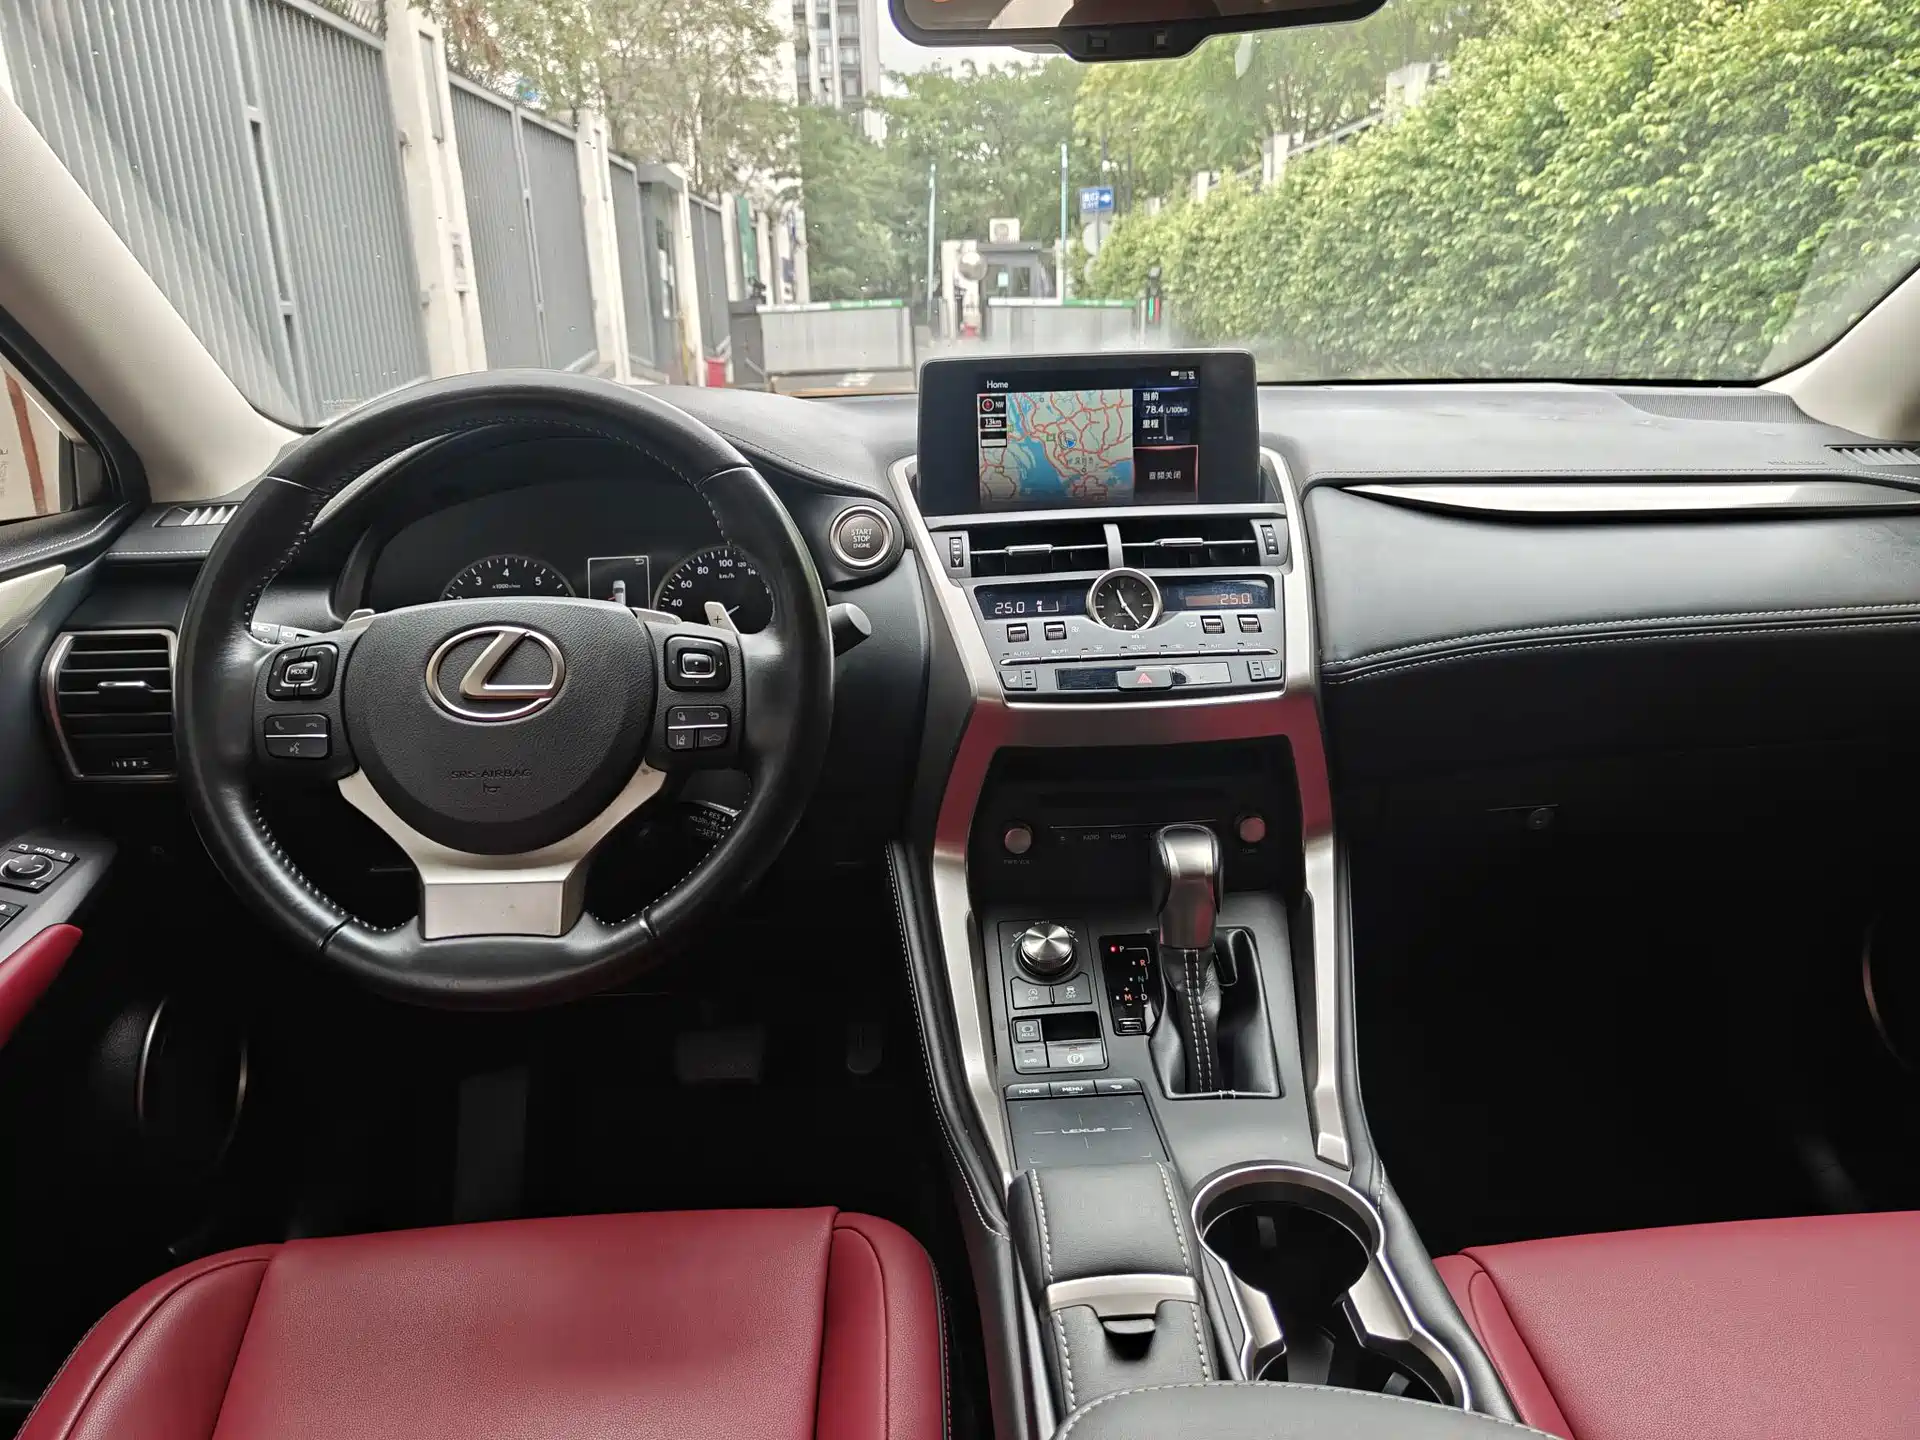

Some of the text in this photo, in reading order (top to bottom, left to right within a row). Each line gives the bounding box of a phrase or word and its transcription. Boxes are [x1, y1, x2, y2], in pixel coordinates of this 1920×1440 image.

[986, 380, 1009, 389] Home
[995, 401, 1005, 409] NW
[1145, 405, 1164, 414] 78.4
[853, 535, 871, 543] STOP
[719, 559, 733, 567] 100
[502, 568, 510, 577] 4
[697, 566, 709, 575] 80
[475, 576, 482, 586] 3
[534, 576, 542, 586] 5
[680, 580, 692, 588] 60
[671, 599, 683, 607] 40
[994, 602, 1025, 614] 25.0
[708, 811, 721, 820] RES
[34, 846, 55, 855] AUTO
[1140, 959, 1146, 967] R
[1141, 993, 1148, 1001] D
[1061, 1127, 1107, 1135] LEXUS
